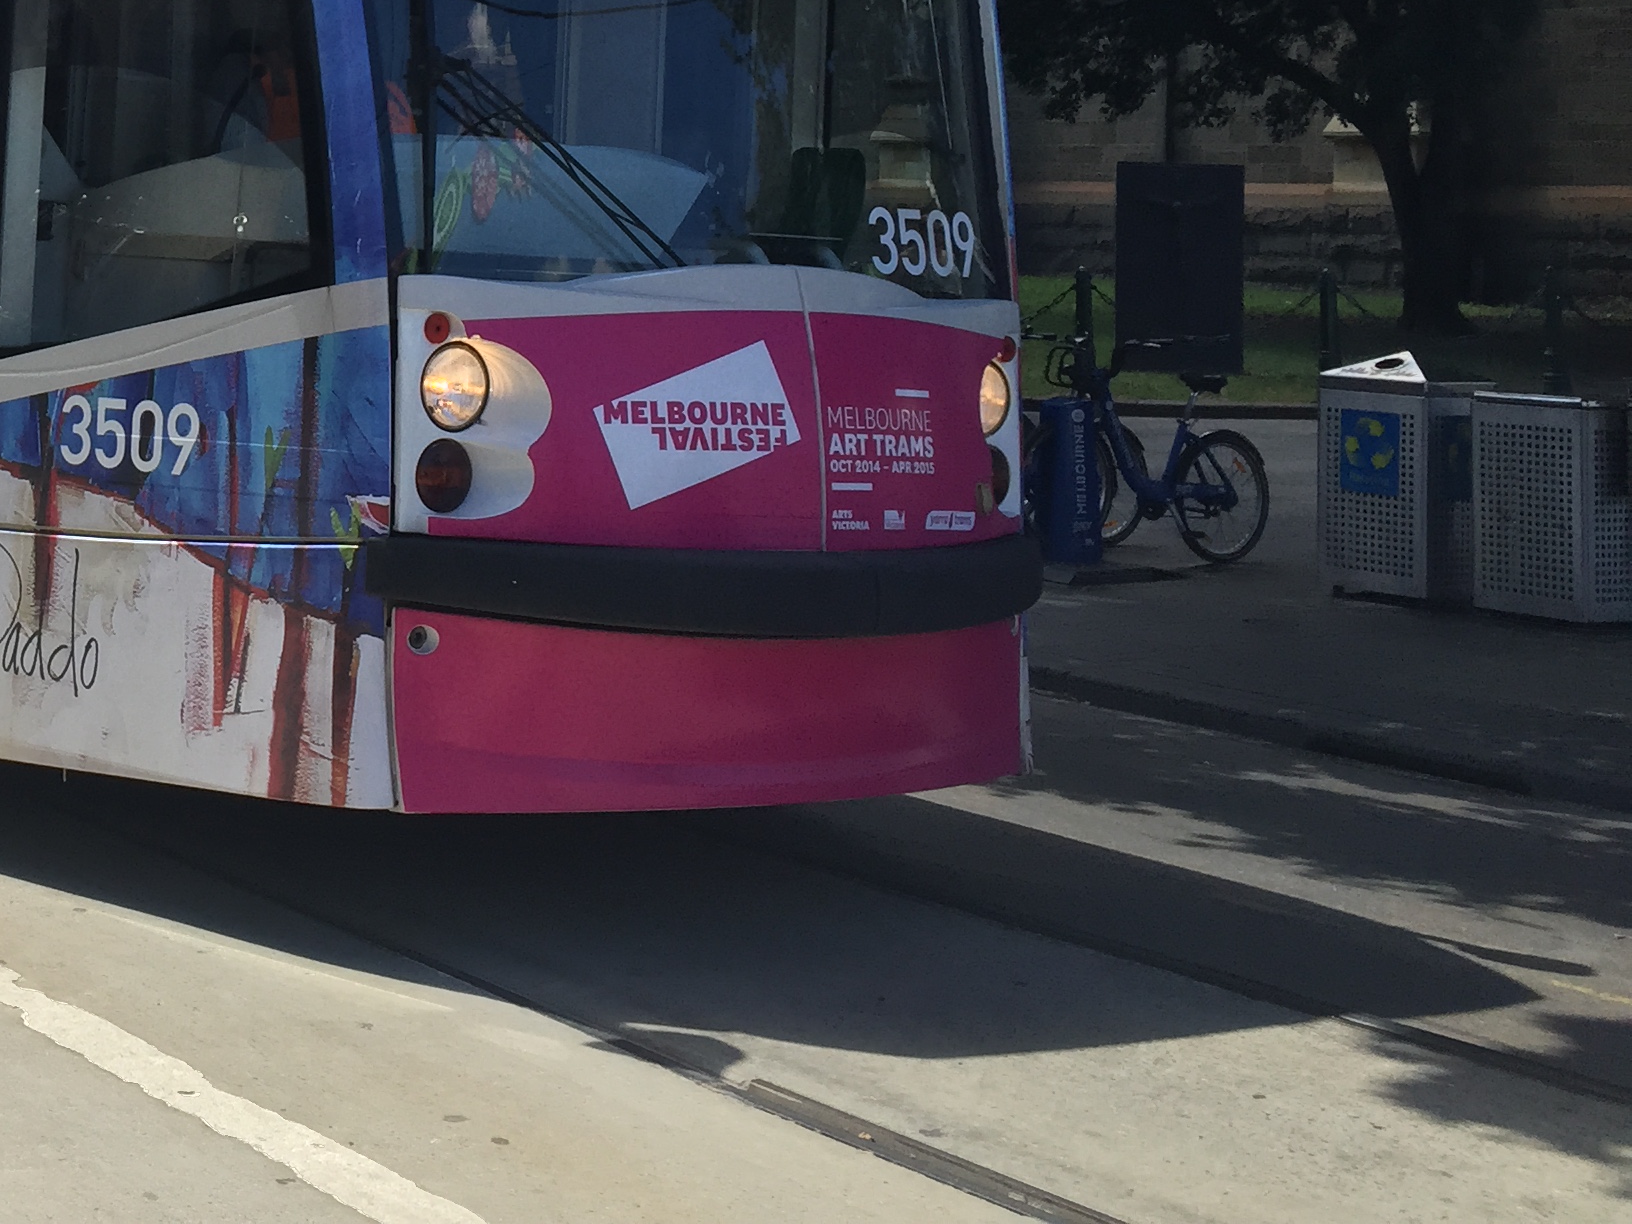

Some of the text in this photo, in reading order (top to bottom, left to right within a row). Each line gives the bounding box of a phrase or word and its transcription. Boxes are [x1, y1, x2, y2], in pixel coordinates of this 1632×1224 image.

[868, 206, 975, 278] 3509
[603, 400, 787, 427] MELBOURNE
[827, 406, 933, 433] MELBOURNE
[60, 394, 200, 476] 3509
[651, 427, 788, 452] FESTIVAL
[829, 433, 935, 458] ART TRAMS
[830, 459, 853, 473] OCT
[855, 460, 881, 473] 2014
[891, 461, 912, 474] APR
[914, 462, 935, 475] 2015
[1073, 425, 1088, 515] MELBOURNE
[831, 520, 871, 531] VICTORIA
[832, 509, 854, 519] ARTS
